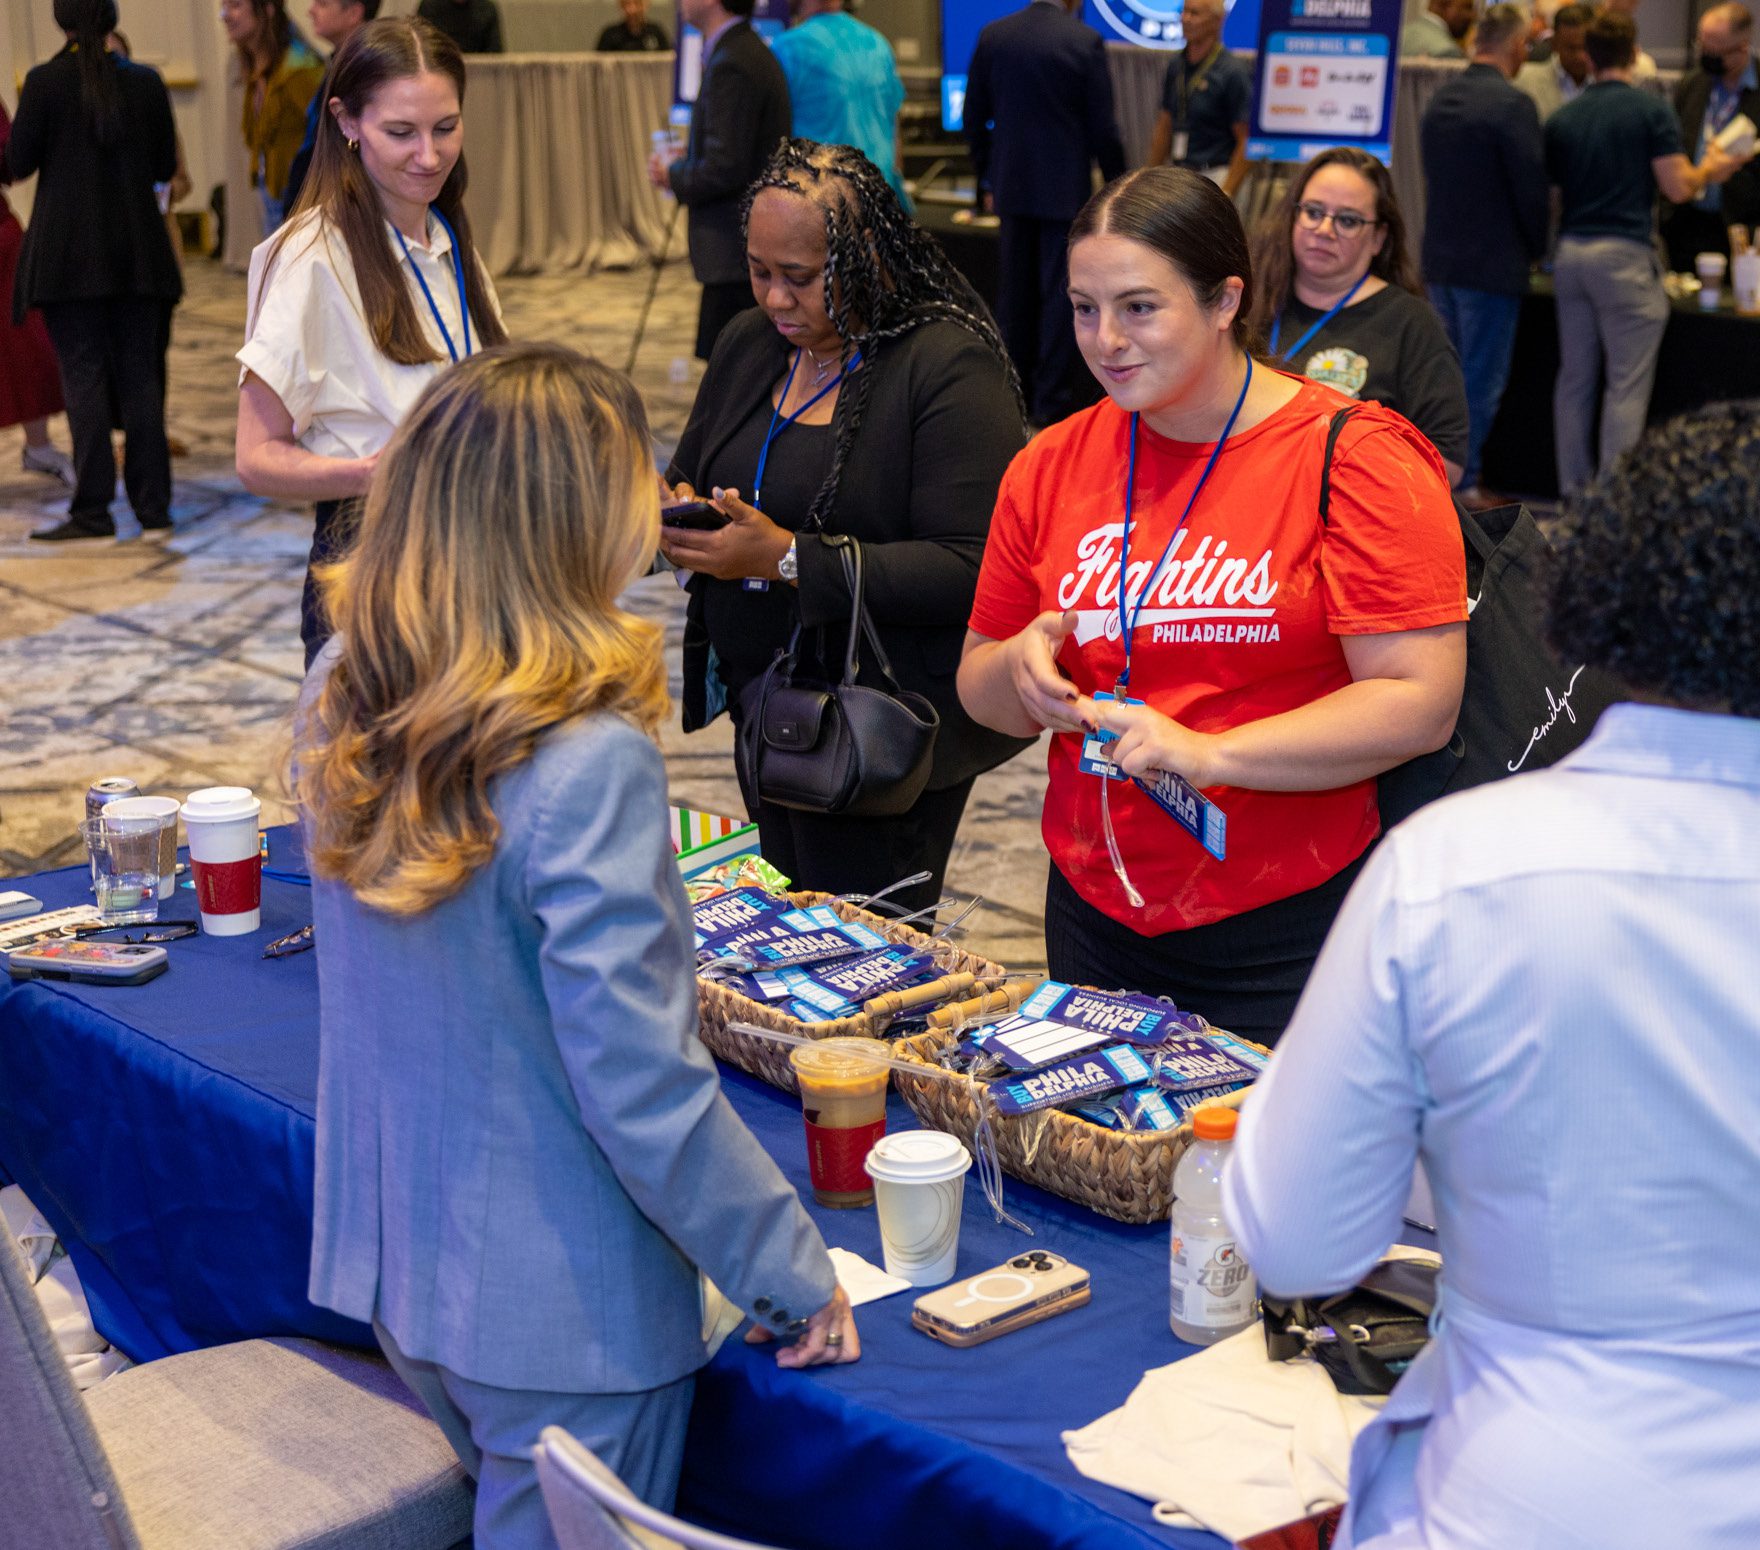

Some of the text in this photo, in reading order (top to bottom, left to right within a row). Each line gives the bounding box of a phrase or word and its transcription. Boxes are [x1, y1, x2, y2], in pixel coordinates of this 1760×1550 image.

[1058, 521, 1278, 642] Fightins
[1153, 623, 1280, 643] PHILADELPHIA
[1155, 782, 1199, 830] ELPHIA
[1157, 768, 1199, 819] HILA
[737, 892, 772, 911] BUY
[695, 904, 762, 933] PHILA
[768, 932, 843, 951] PHILA
[825, 956, 892, 984] DELPHIA
[1072, 995, 1146, 1018] DELPHIA
[1078, 991, 1167, 1016] SUPPORTING LOCAL BUSINESS
[1064, 1003, 1140, 1033] PHILA
[1134, 1014, 1163, 1036] BUY
[1021, 1061, 1105, 1090] PHILA
[1028, 1072, 1111, 1100] DELPHIA
[1006, 1084, 1035, 1105] BUY
[1020, 1093, 1063, 1109] SUPPORTING
[1062, 1088, 1083, 1099] LOCAL
[1197, 1263, 1250, 1287] ZERO
